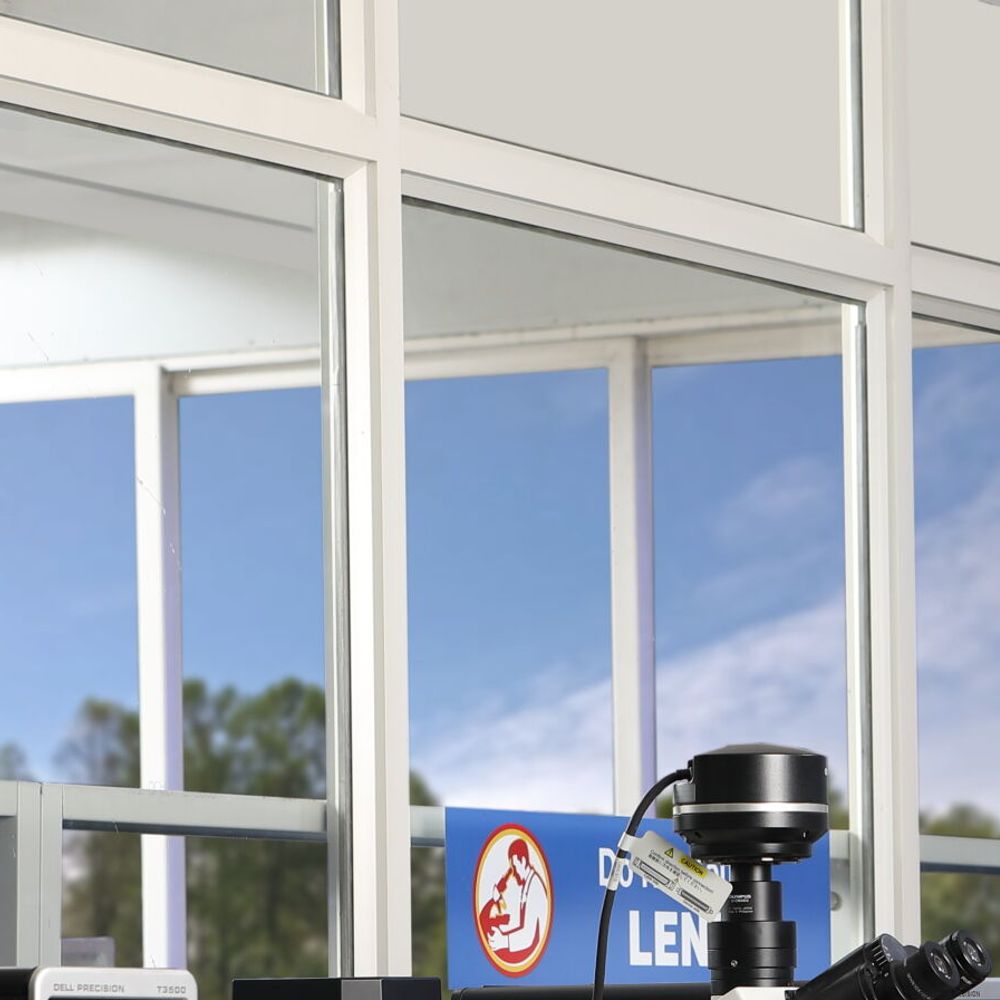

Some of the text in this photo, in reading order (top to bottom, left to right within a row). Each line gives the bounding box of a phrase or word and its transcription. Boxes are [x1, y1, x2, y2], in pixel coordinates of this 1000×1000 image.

[679, 856, 705, 875] CAUTION
[629, 910, 709, 966] LEN
[53, 983, 187, 994] DELL PRECISION T3500
